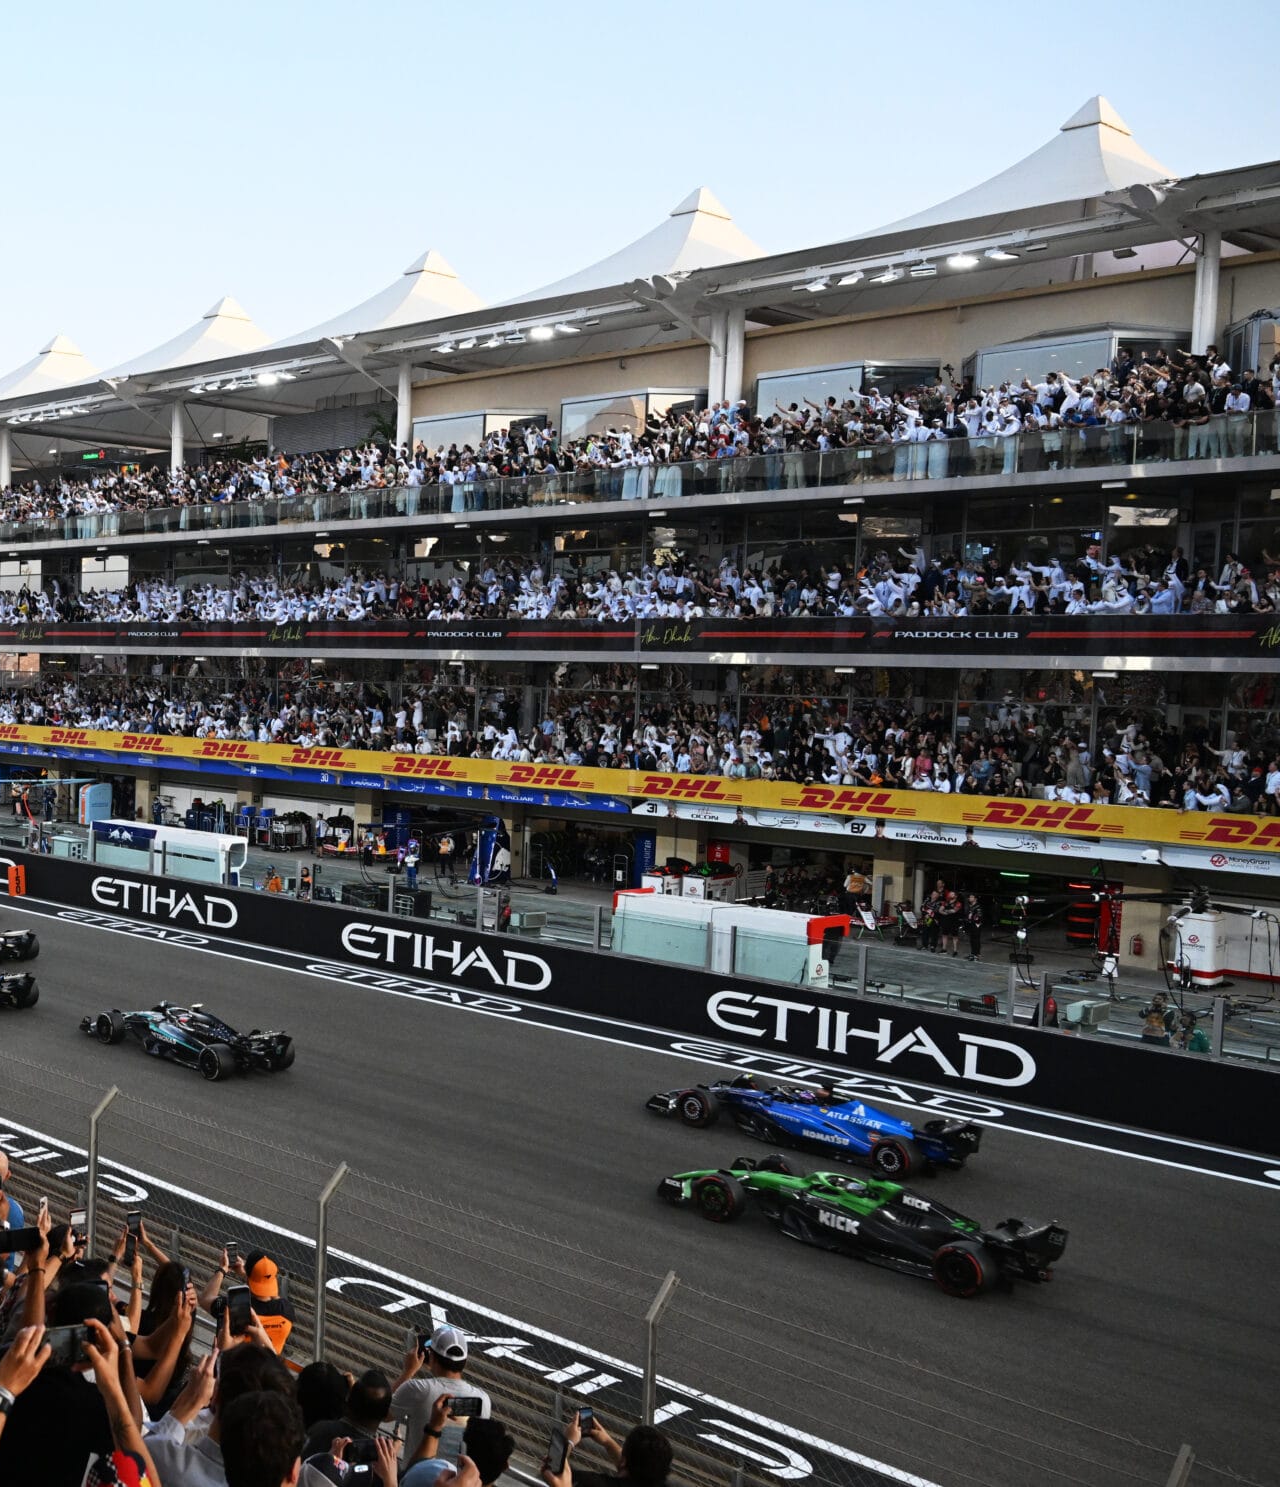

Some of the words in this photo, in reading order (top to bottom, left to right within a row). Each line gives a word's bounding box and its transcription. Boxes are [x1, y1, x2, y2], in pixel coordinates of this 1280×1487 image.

[640, 625, 659, 642] Abu
[663, 625, 694, 644] Dhabi
[894, 631, 971, 639] PADDOCK
[975, 631, 1019, 639] CLUB
[49, 730, 89, 746] DHL
[121, 735, 165, 751] DHL
[200, 741, 250, 759] DHL
[290, 748, 346, 767] DHL
[392, 756, 456, 777] DHL
[320, 773, 329, 783] 30
[351, 780, 381, 788] LAWSON
[508, 765, 580, 788] DHL
[467, 786, 473, 796] 6
[642, 776, 725, 800] DHL
[798, 787, 896, 815] DHL
[646, 803, 658, 814] 31
[691, 813, 719, 821] OCON
[982, 801, 1101, 831] DHL
[851, 823, 867, 834] 87
[895, 832, 957, 843] BEARMAN
[1229, 856, 1270, 866] MoneyGram
[91, 876, 239, 929] ETIHAD
[57, 911, 209, 945] ETIHAD
[341, 922, 553, 992] ETIHAD
[306, 964, 523, 1013] ETIHAD
[152, 1031, 177, 1045] PETRONAS
[706, 990, 1037, 1088] ETIHAD
[670, 1042, 1005, 1117] ETIHAD
[826, 1111, 883, 1130] ATLASSIAN
[802, 1129, 850, 1146] KOMATSU
[902, 1195, 932, 1212] KICK
[819, 1209, 861, 1236] KICK
